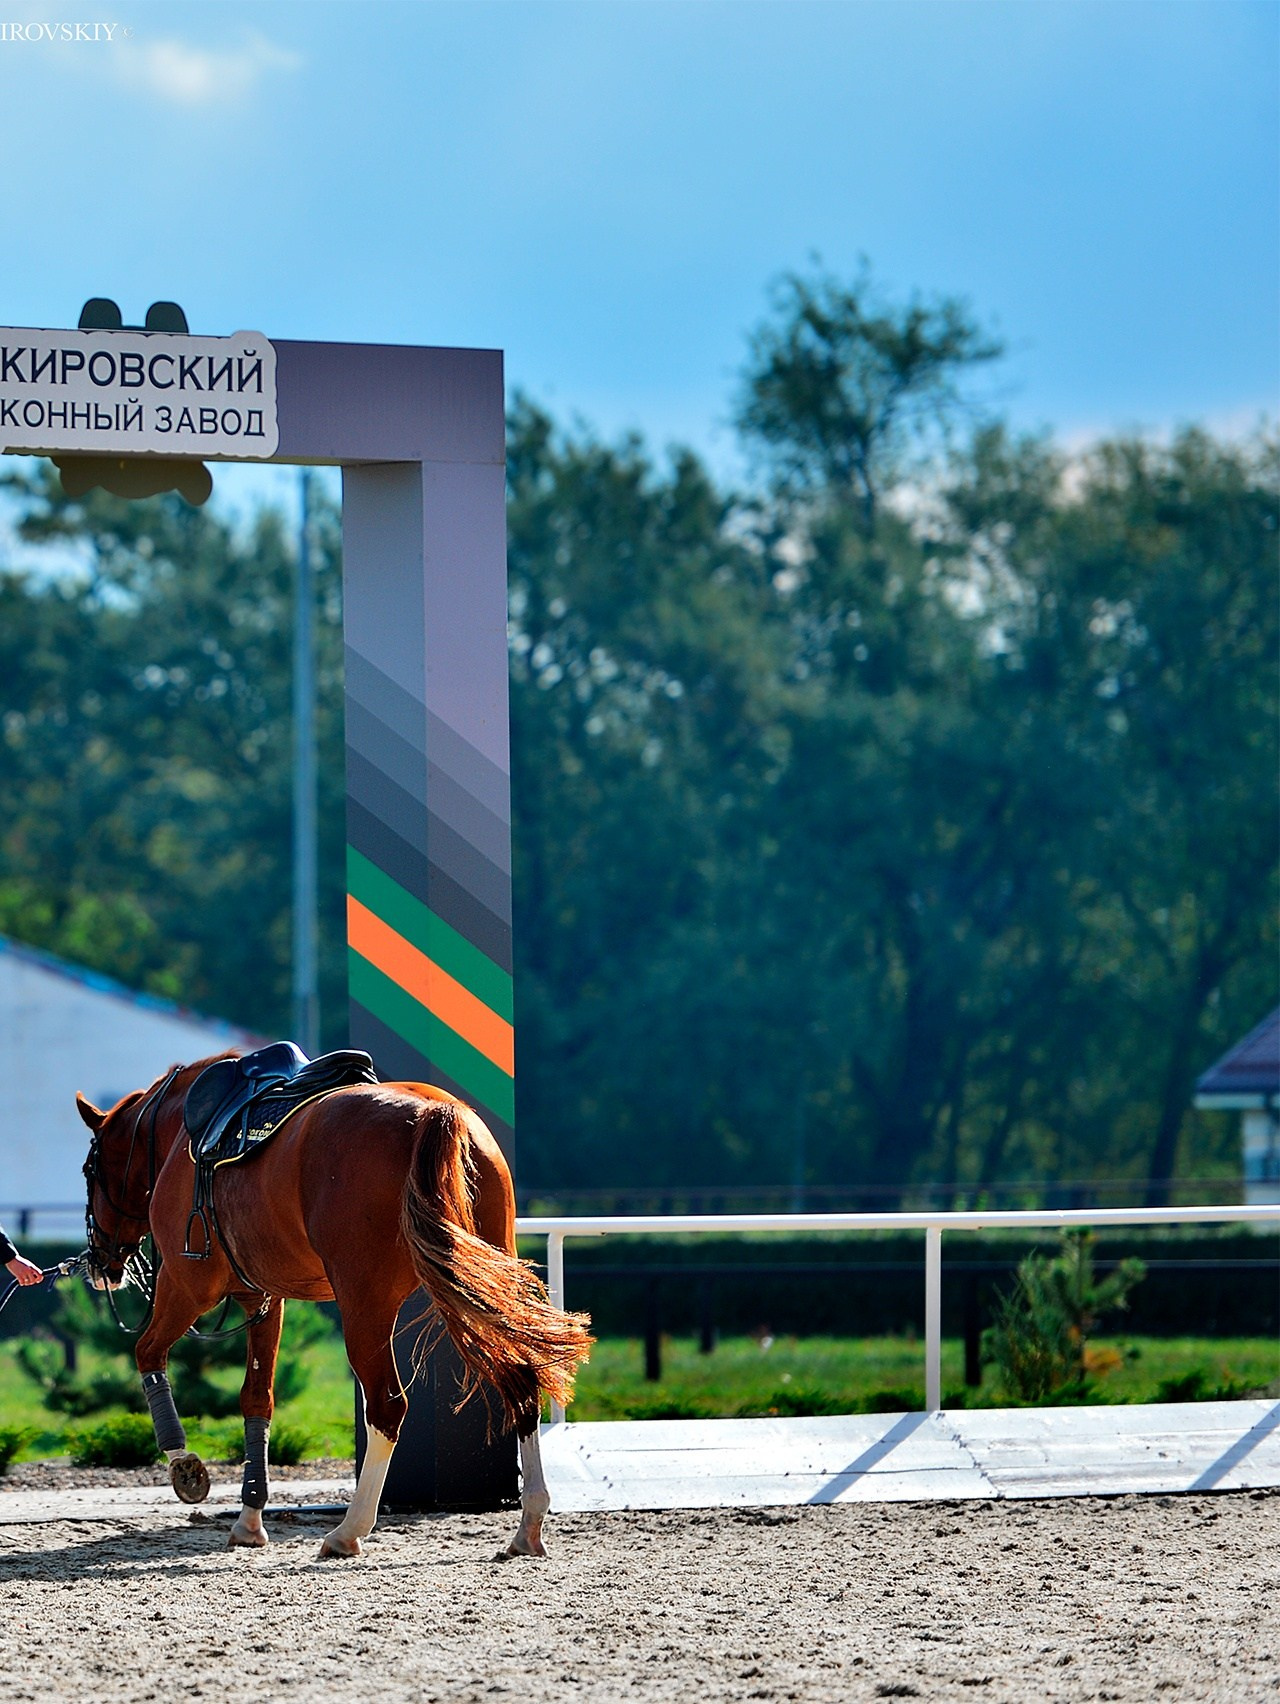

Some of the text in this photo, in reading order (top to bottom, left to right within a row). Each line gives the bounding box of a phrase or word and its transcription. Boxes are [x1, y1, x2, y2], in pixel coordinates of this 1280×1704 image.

[0, 346, 264, 394] КИРОВСКИЙ
[0, 397, 267, 437] КОННЫЙ ЗАВОД
